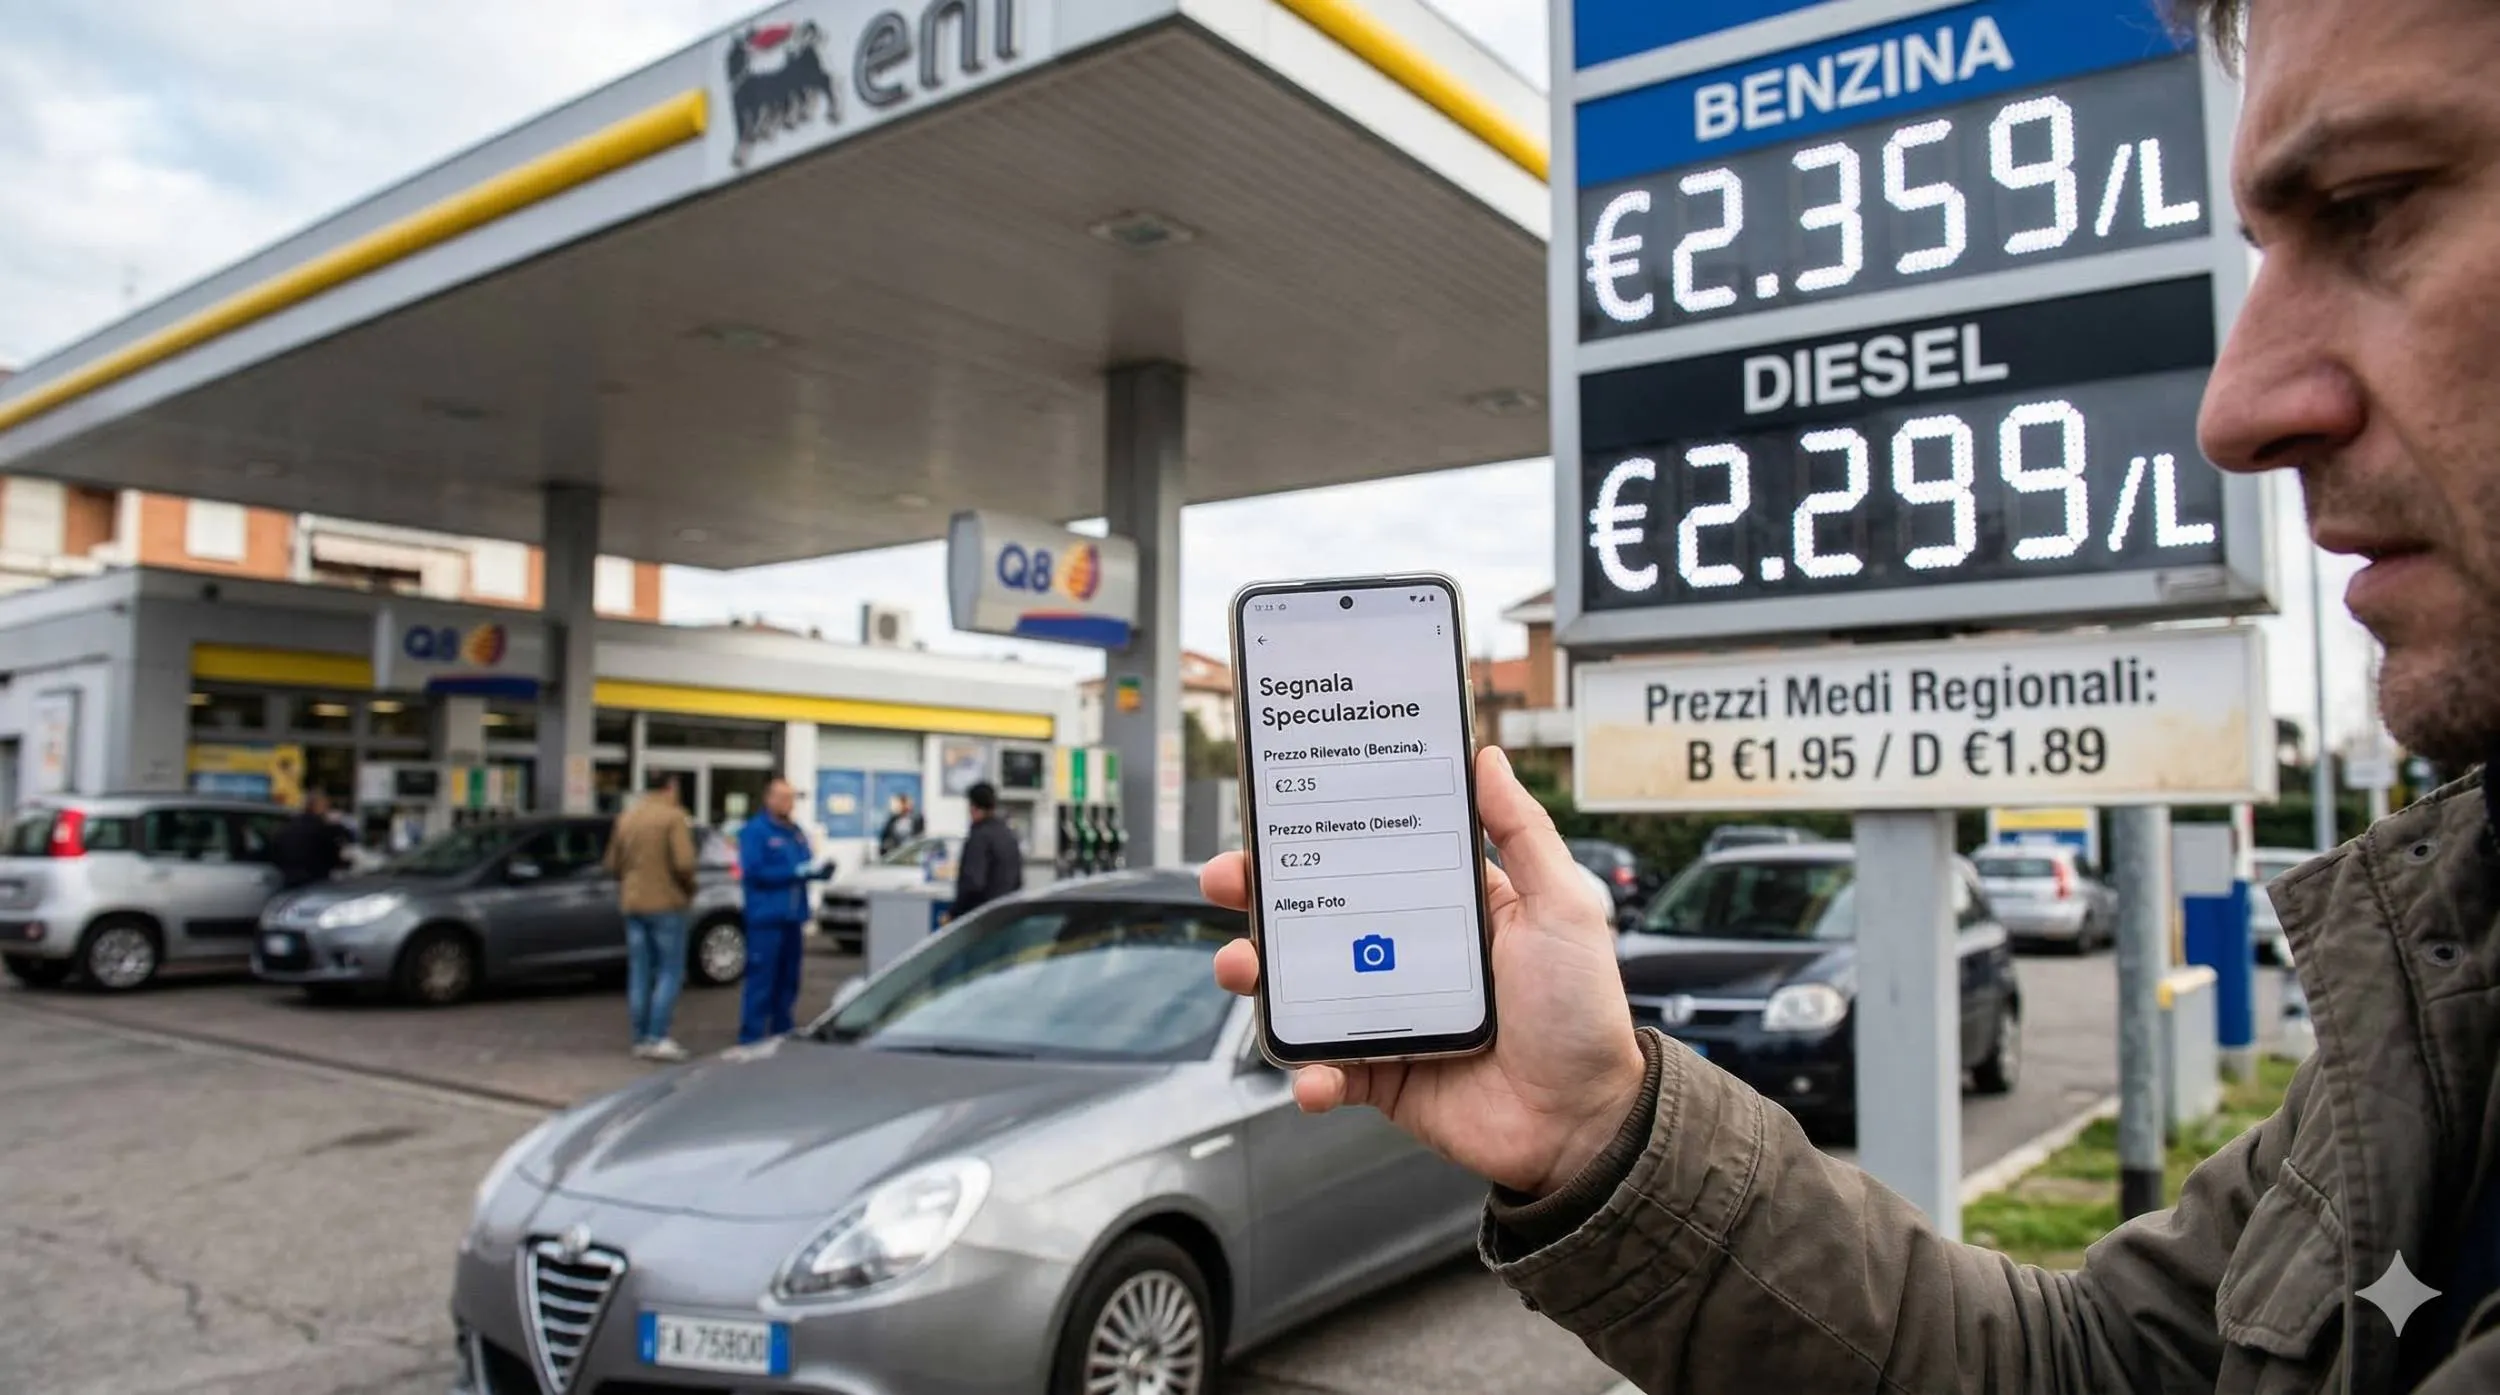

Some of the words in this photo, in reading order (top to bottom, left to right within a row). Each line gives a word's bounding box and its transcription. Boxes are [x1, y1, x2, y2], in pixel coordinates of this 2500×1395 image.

[1694, 16, 2014, 142] BENZINA
[1586, 95, 2200, 322] €2.359/L
[1743, 323, 2009, 414] DIESEL
[1590, 400, 2216, 592] €2.299/L
[997, 542, 1053, 593] Q8
[1260, 673, 1353, 700] Segnala
[1646, 678, 1768, 724] Prezzi
[1786, 670, 1891, 717] Medi
[1911, 657, 2156, 720] Regionali:
[1262, 700, 1420, 731] Speculazione
[1264, 750, 1307, 762] Prezzo
[1310, 745, 1361, 759] Rilevato
[1364, 740, 1427, 758] (Benzina):
[1687, 740, 1714, 782] B
[1732, 736, 1856, 782] €1.95
[1874, 732, 1892, 779] /
[1911, 732, 1941, 777] D
[1963, 727, 2107, 776] €1.89
[1275, 778, 1316, 793] €2.35
[1269, 824, 1312, 836] Prezzo
[1315, 819, 1366, 834] Rilevato
[1369, 814, 1422, 832] (Diesel):
[1280, 852, 1321, 867] €2.29
[1274, 899, 1314, 912] Allega
[1317, 896, 1346, 908] Foto
